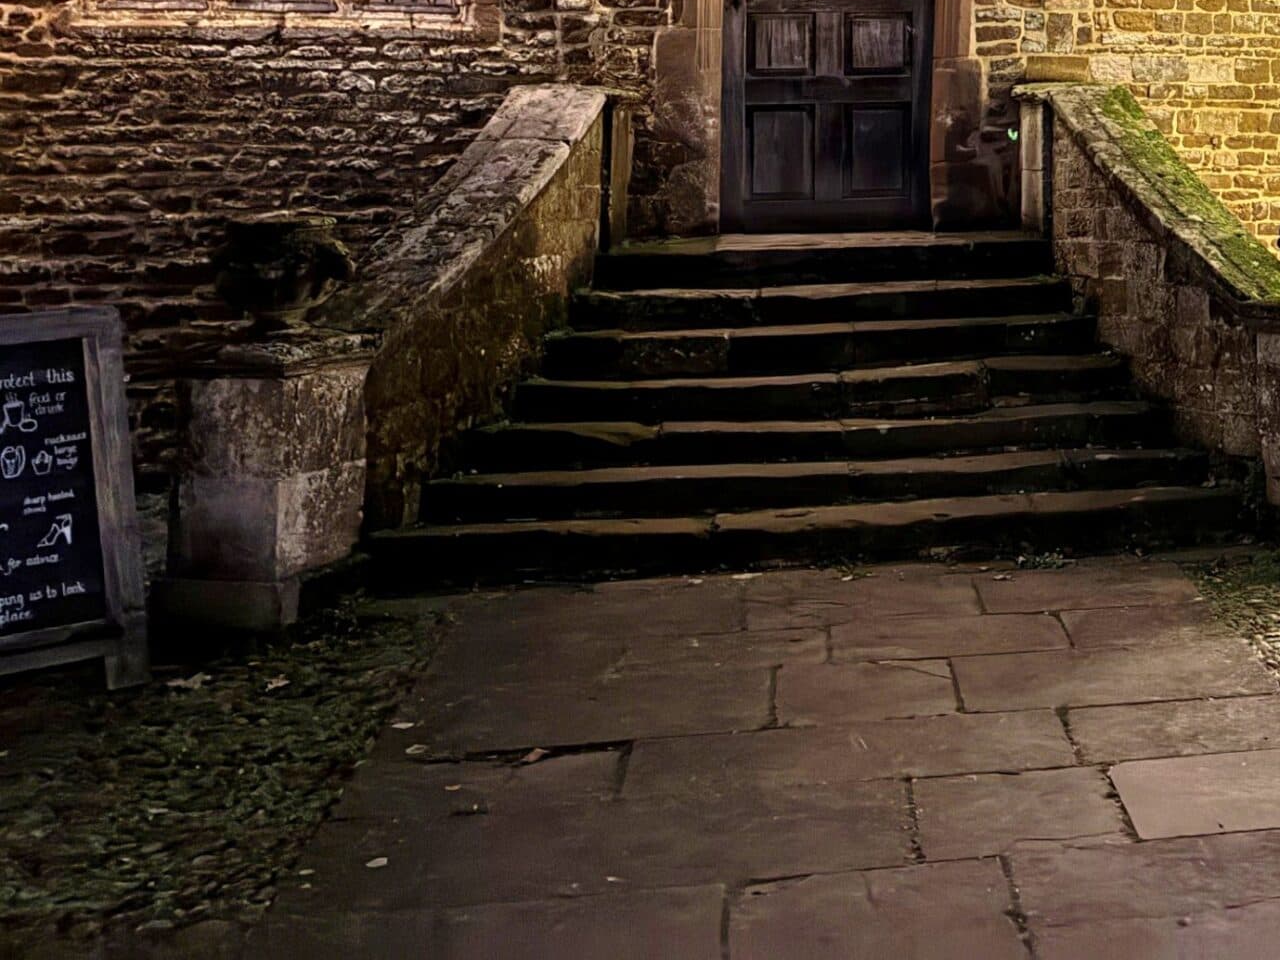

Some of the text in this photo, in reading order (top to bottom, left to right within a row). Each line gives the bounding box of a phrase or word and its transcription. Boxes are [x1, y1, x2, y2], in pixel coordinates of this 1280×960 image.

[46, 368, 75, 384] this
[3, 557, 22, 576] for
[29, 590, 43, 601] us
[46, 585, 57, 598] to
[61, 581, 86, 597] look
